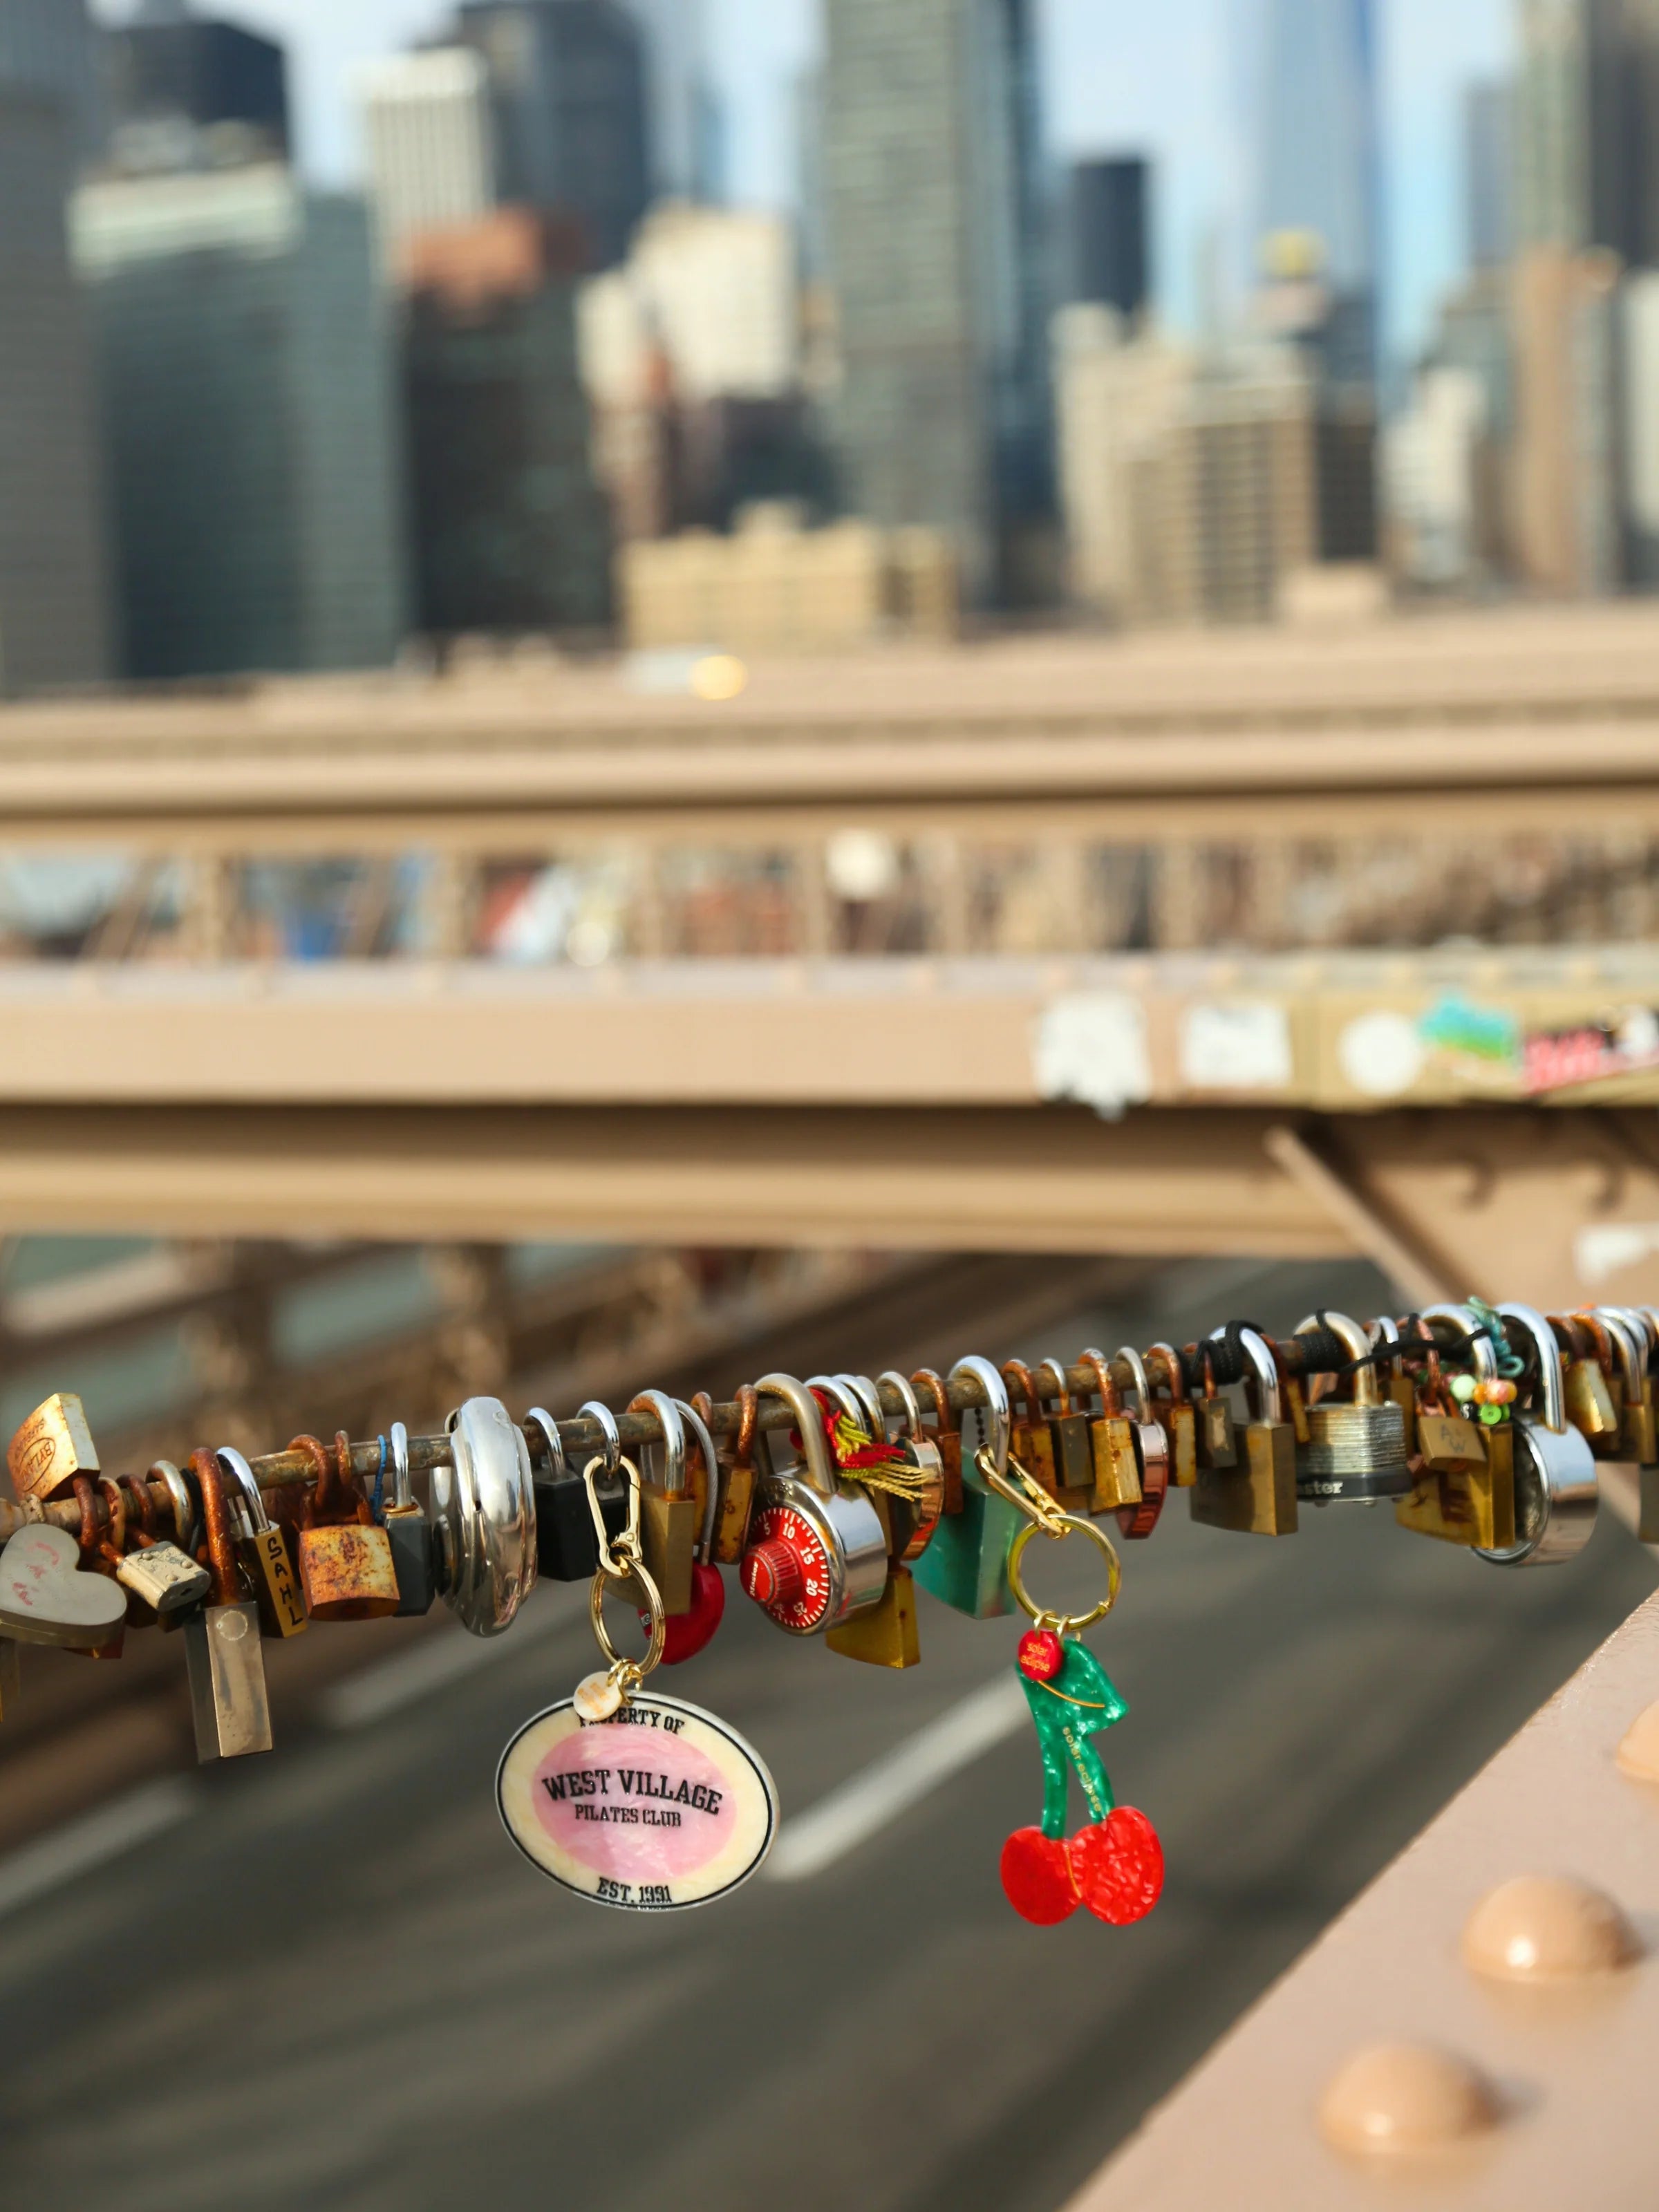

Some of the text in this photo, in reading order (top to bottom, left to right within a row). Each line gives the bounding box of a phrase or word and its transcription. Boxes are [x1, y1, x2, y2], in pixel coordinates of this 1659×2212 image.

[764, 1522, 771, 1536] 5
[782, 1523, 796, 1540] 10
[800, 1546, 816, 1566] 15
[267, 1536, 304, 1627] SAHL
[806, 1577, 819, 1597] 20
[794, 1602, 807, 1617] 25
[1027, 1642, 1049, 1657] solar
[1020, 1654, 1051, 1673] eclipse
[577, 1707, 685, 1735] ERTY OF
[1062, 1726, 1082, 1760] solar
[541, 1769, 723, 1816] WEST VILLAGE
[574, 1803, 682, 1827] PILATES CLUB
[597, 1876, 673, 1903] EST. 1991
